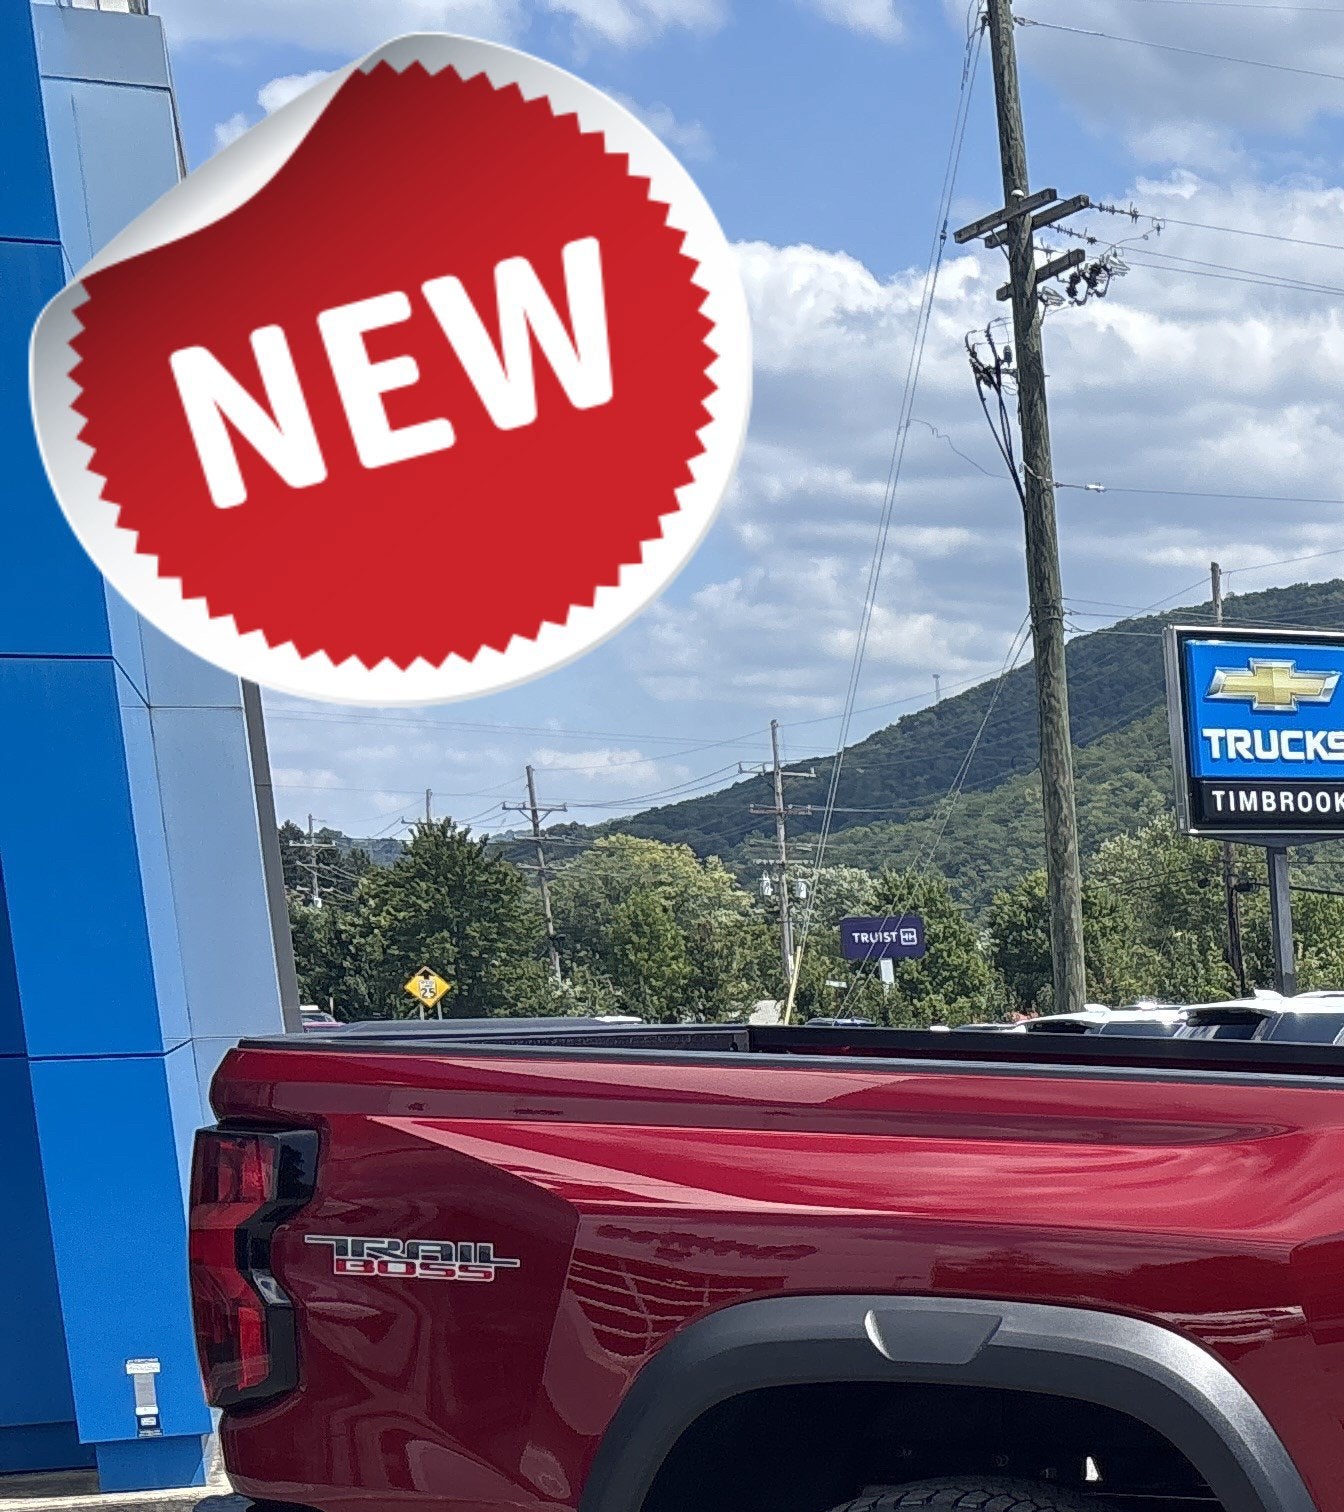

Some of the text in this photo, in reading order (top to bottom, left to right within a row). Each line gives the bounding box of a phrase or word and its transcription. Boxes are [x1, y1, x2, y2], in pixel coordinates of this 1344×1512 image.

[851, 930, 898, 945] TRUIST
[420, 987, 436, 999] 25
[304, 1234, 521, 1268] TRAIL
[333, 1257, 496, 1283] BOSS
